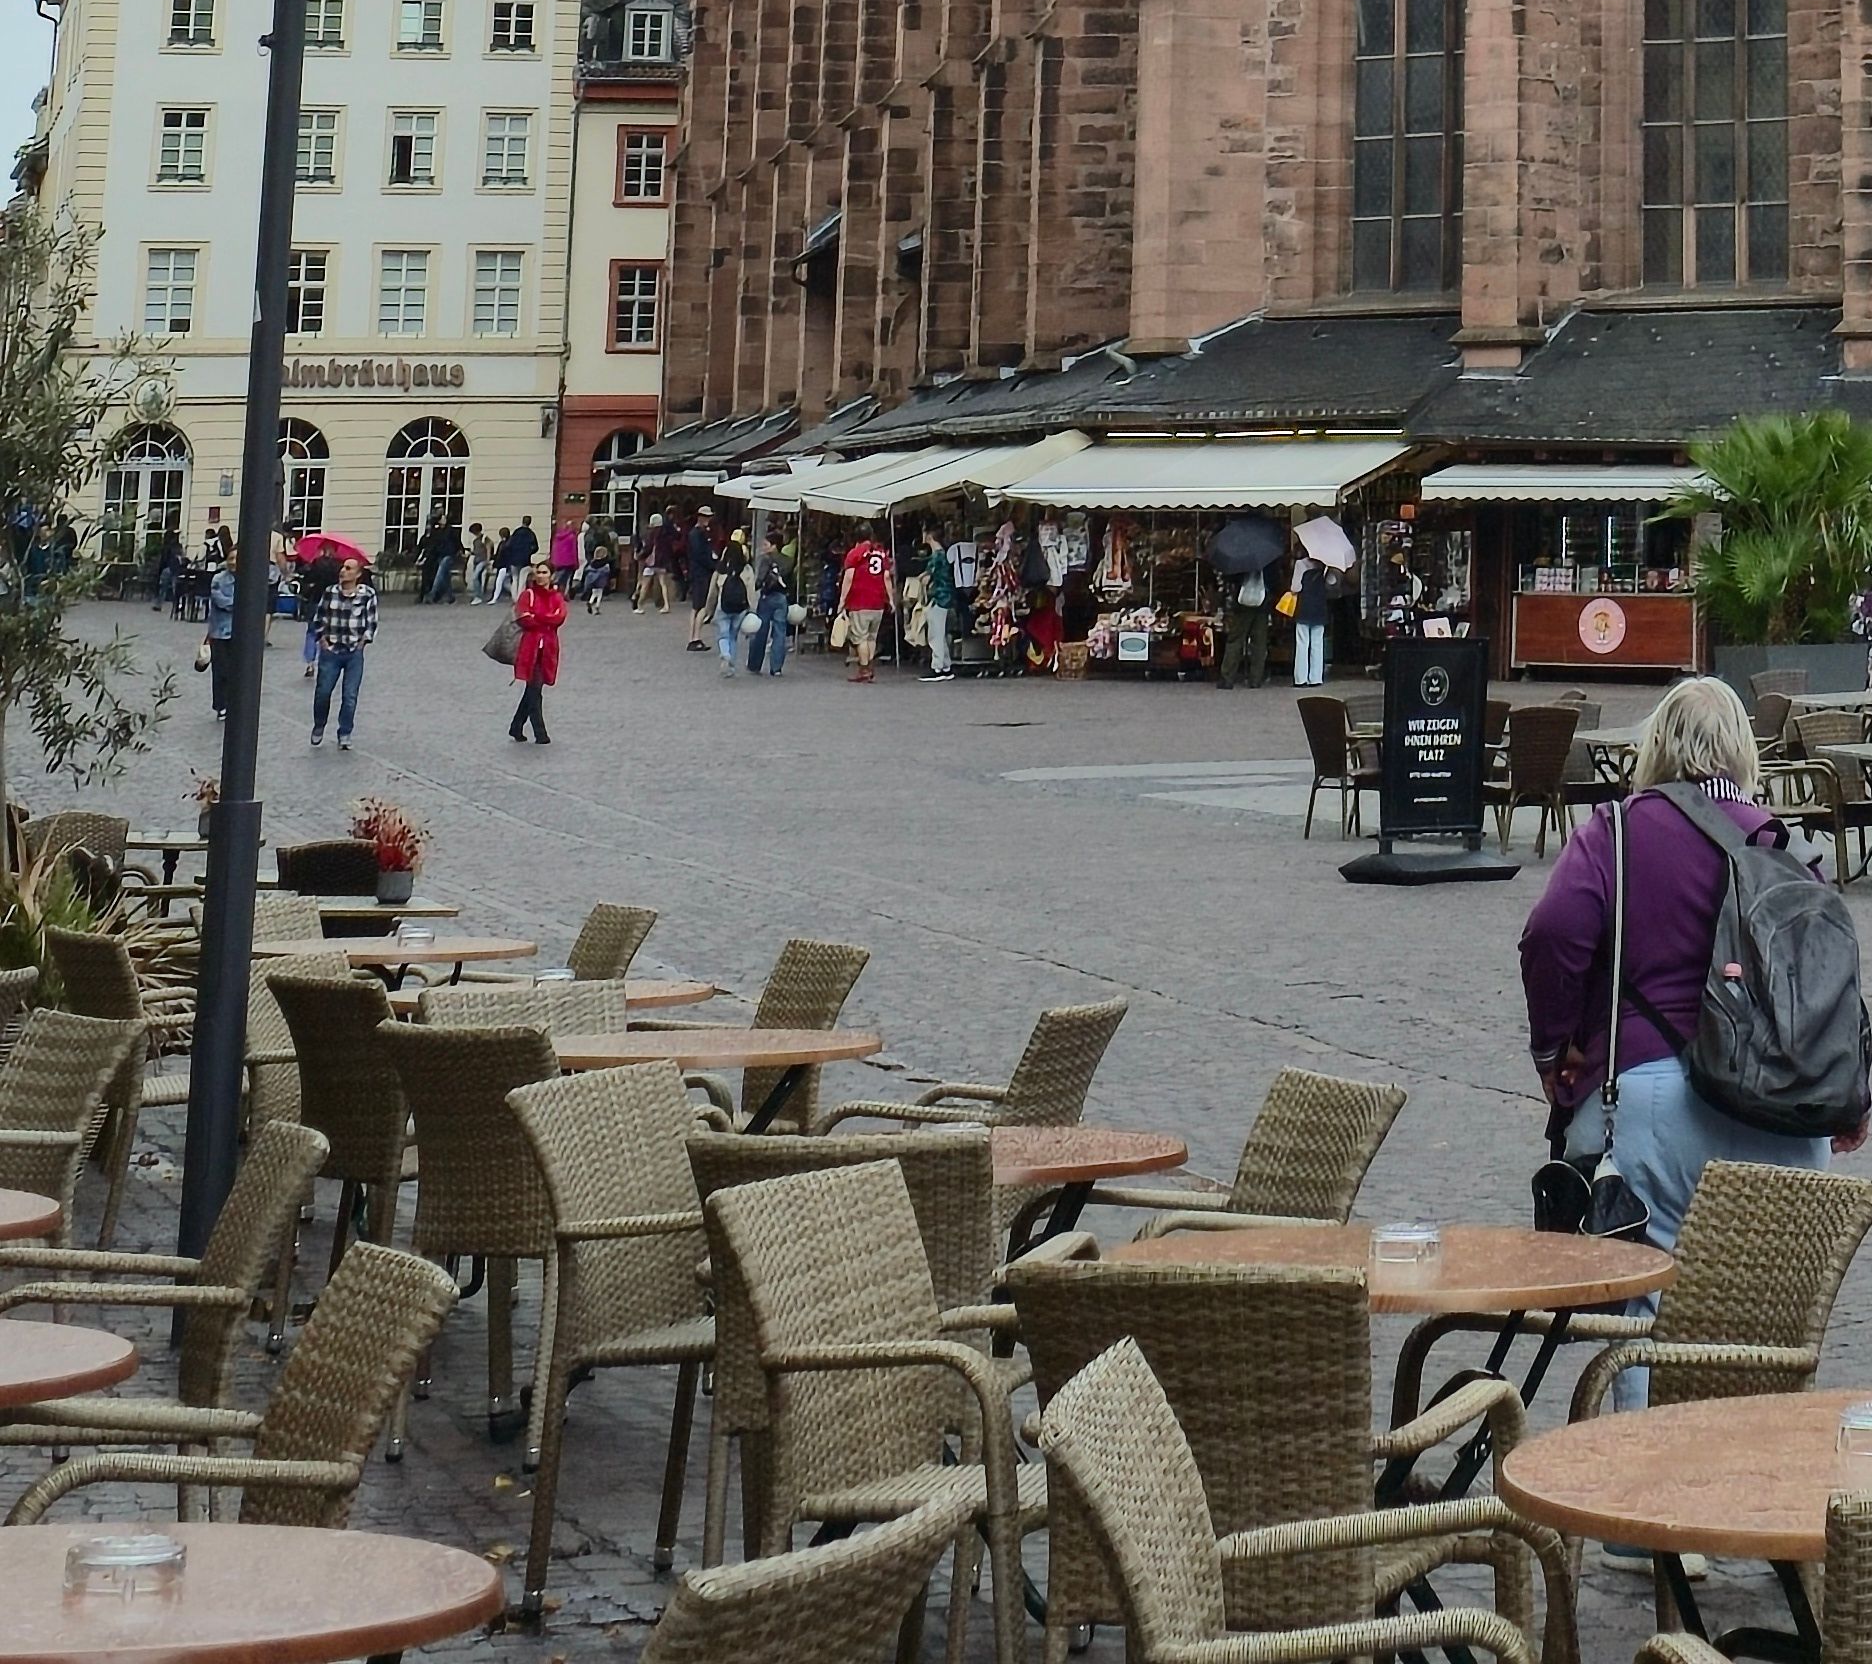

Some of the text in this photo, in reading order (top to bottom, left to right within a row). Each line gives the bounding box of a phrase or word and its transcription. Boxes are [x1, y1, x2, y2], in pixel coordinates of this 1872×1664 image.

[281, 357, 465, 393] almbräuhaus
[868, 555, 883, 575] 3
[1408, 719, 1459, 732] WIR ZEIGEN
[1418, 749, 1445, 762] PLATZ
